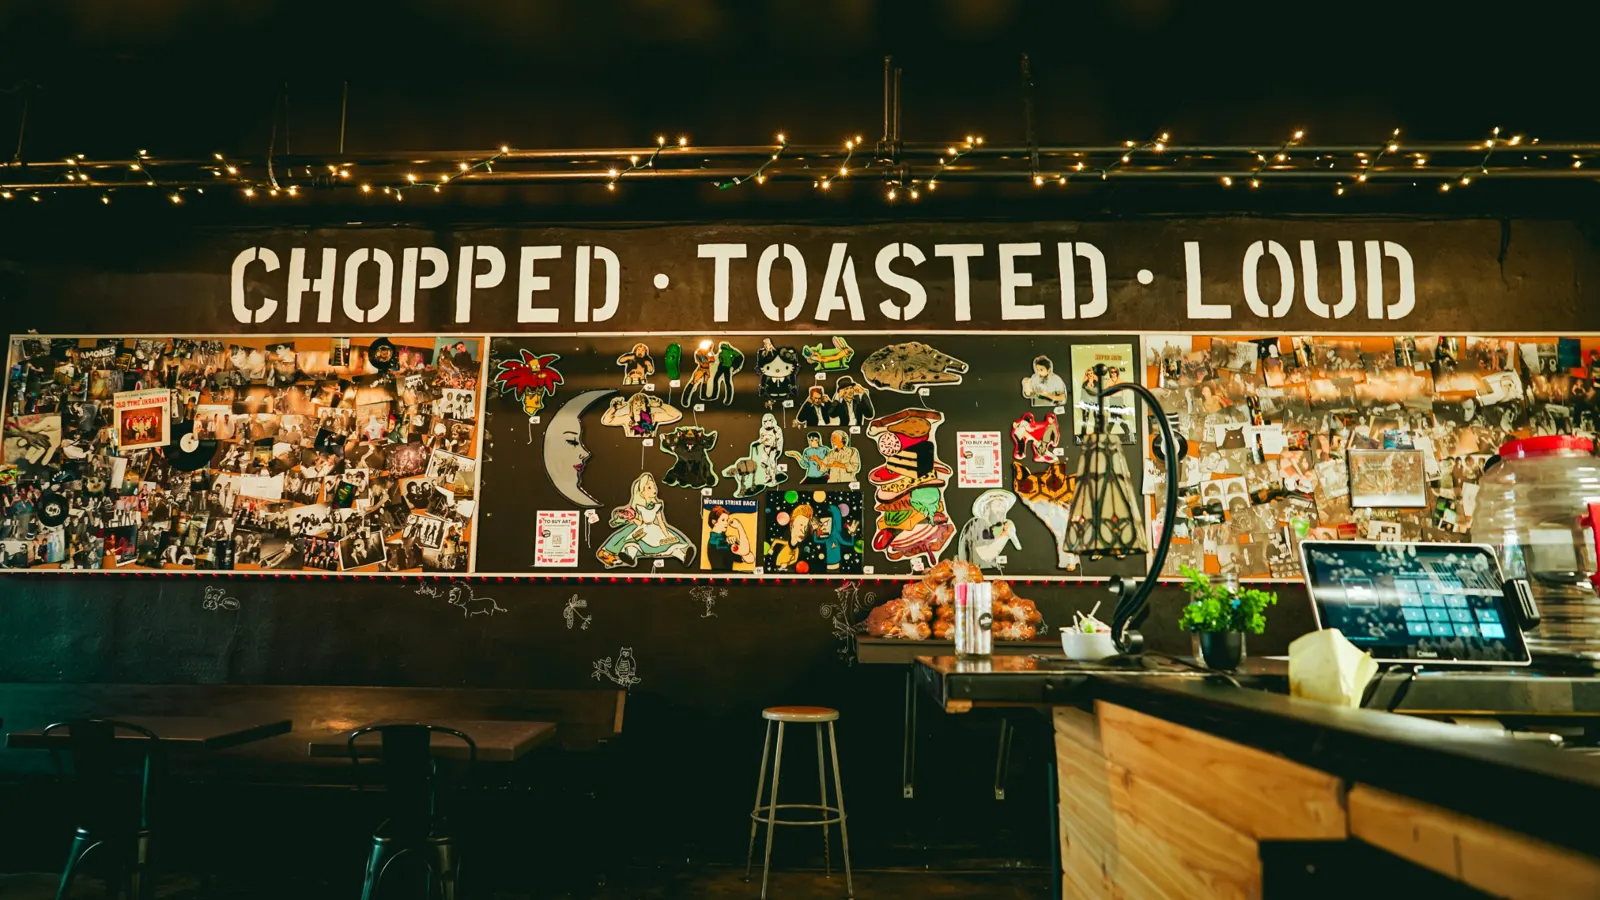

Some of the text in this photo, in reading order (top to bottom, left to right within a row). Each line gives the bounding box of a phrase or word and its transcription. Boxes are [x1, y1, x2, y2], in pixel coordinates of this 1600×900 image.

[232, 240, 1415, 324] CHOPPED TOASTED LOUD
